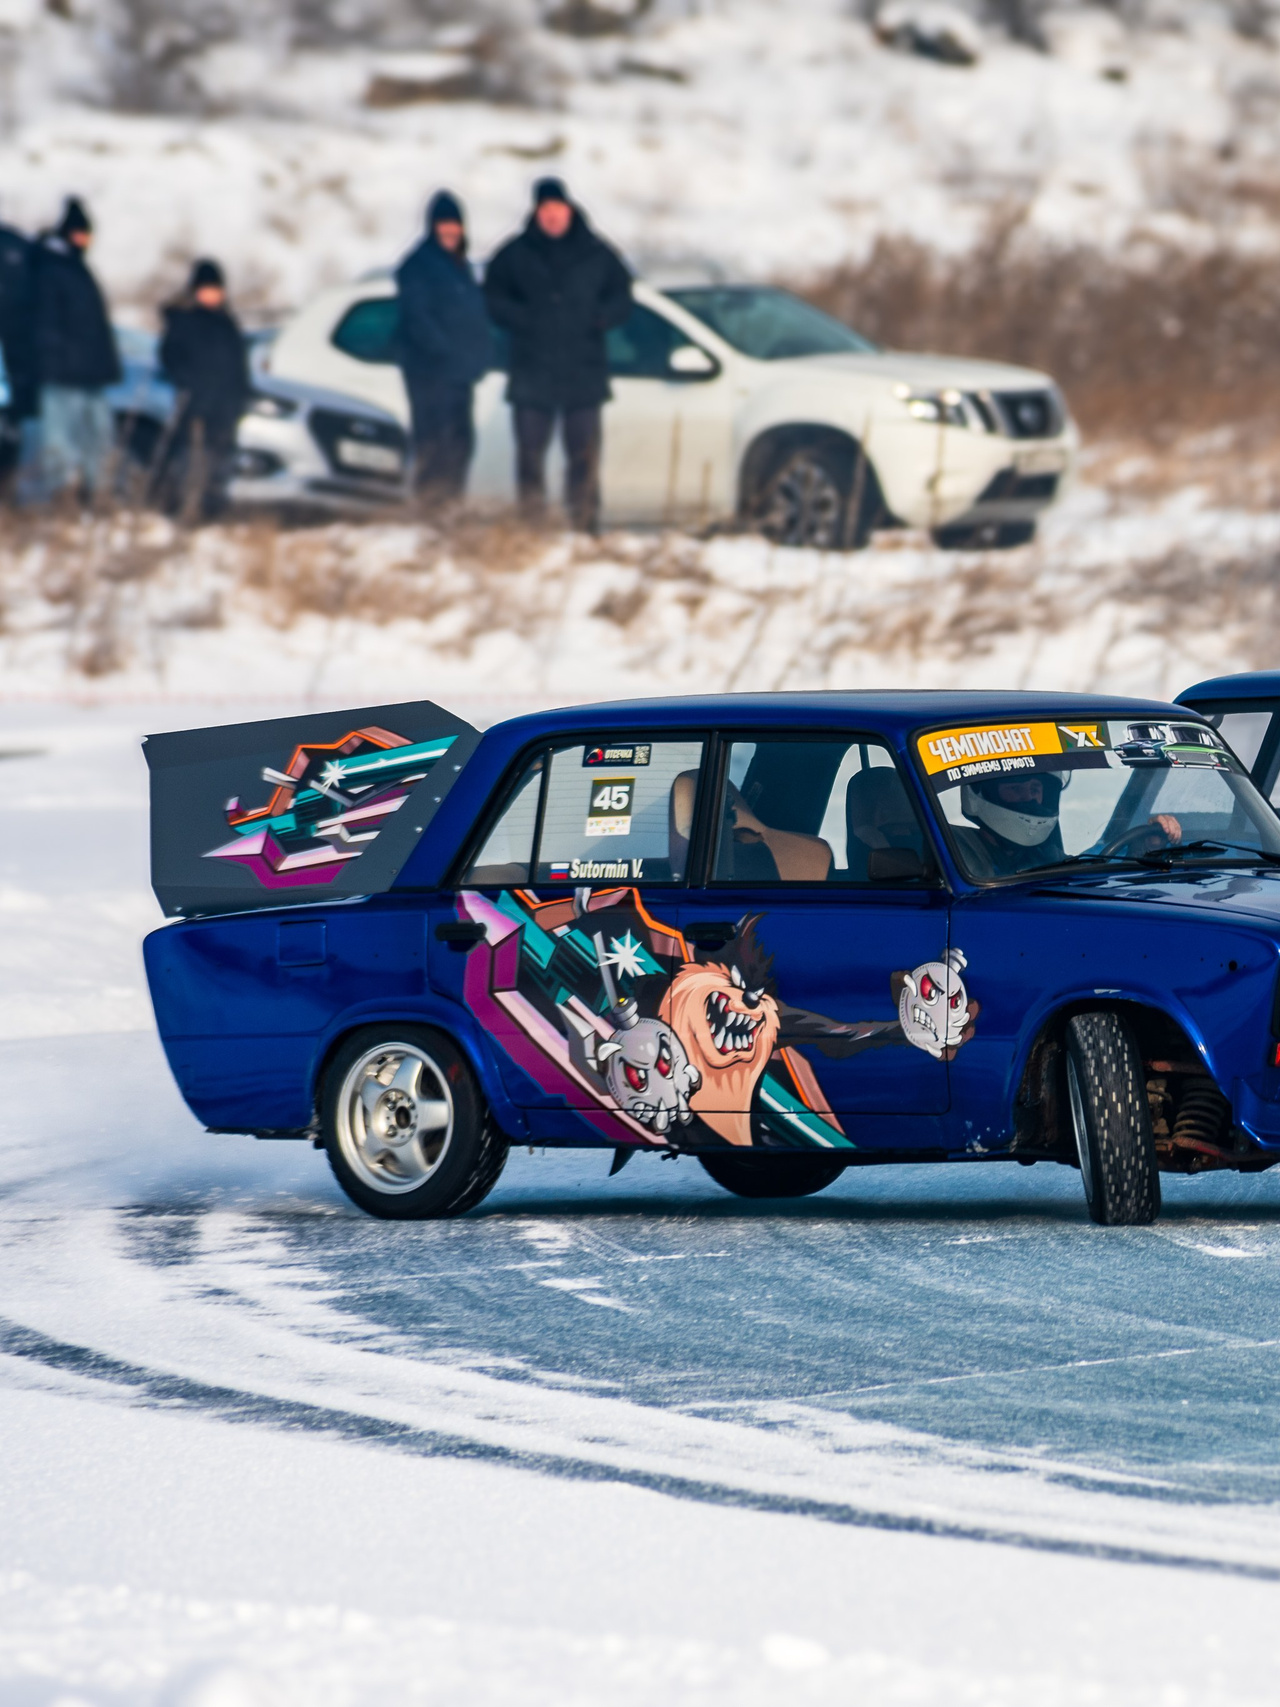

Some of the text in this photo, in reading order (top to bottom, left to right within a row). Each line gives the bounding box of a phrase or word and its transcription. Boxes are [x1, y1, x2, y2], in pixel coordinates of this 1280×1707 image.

[928, 728, 1035, 763] ЧЕМПИОНАТ
[946, 756, 1035, 781] ПО ЗИМНЕМУ ДРИФТУ
[593, 786, 630, 810] 45
[570, 858, 644, 879] Sutormin V.
